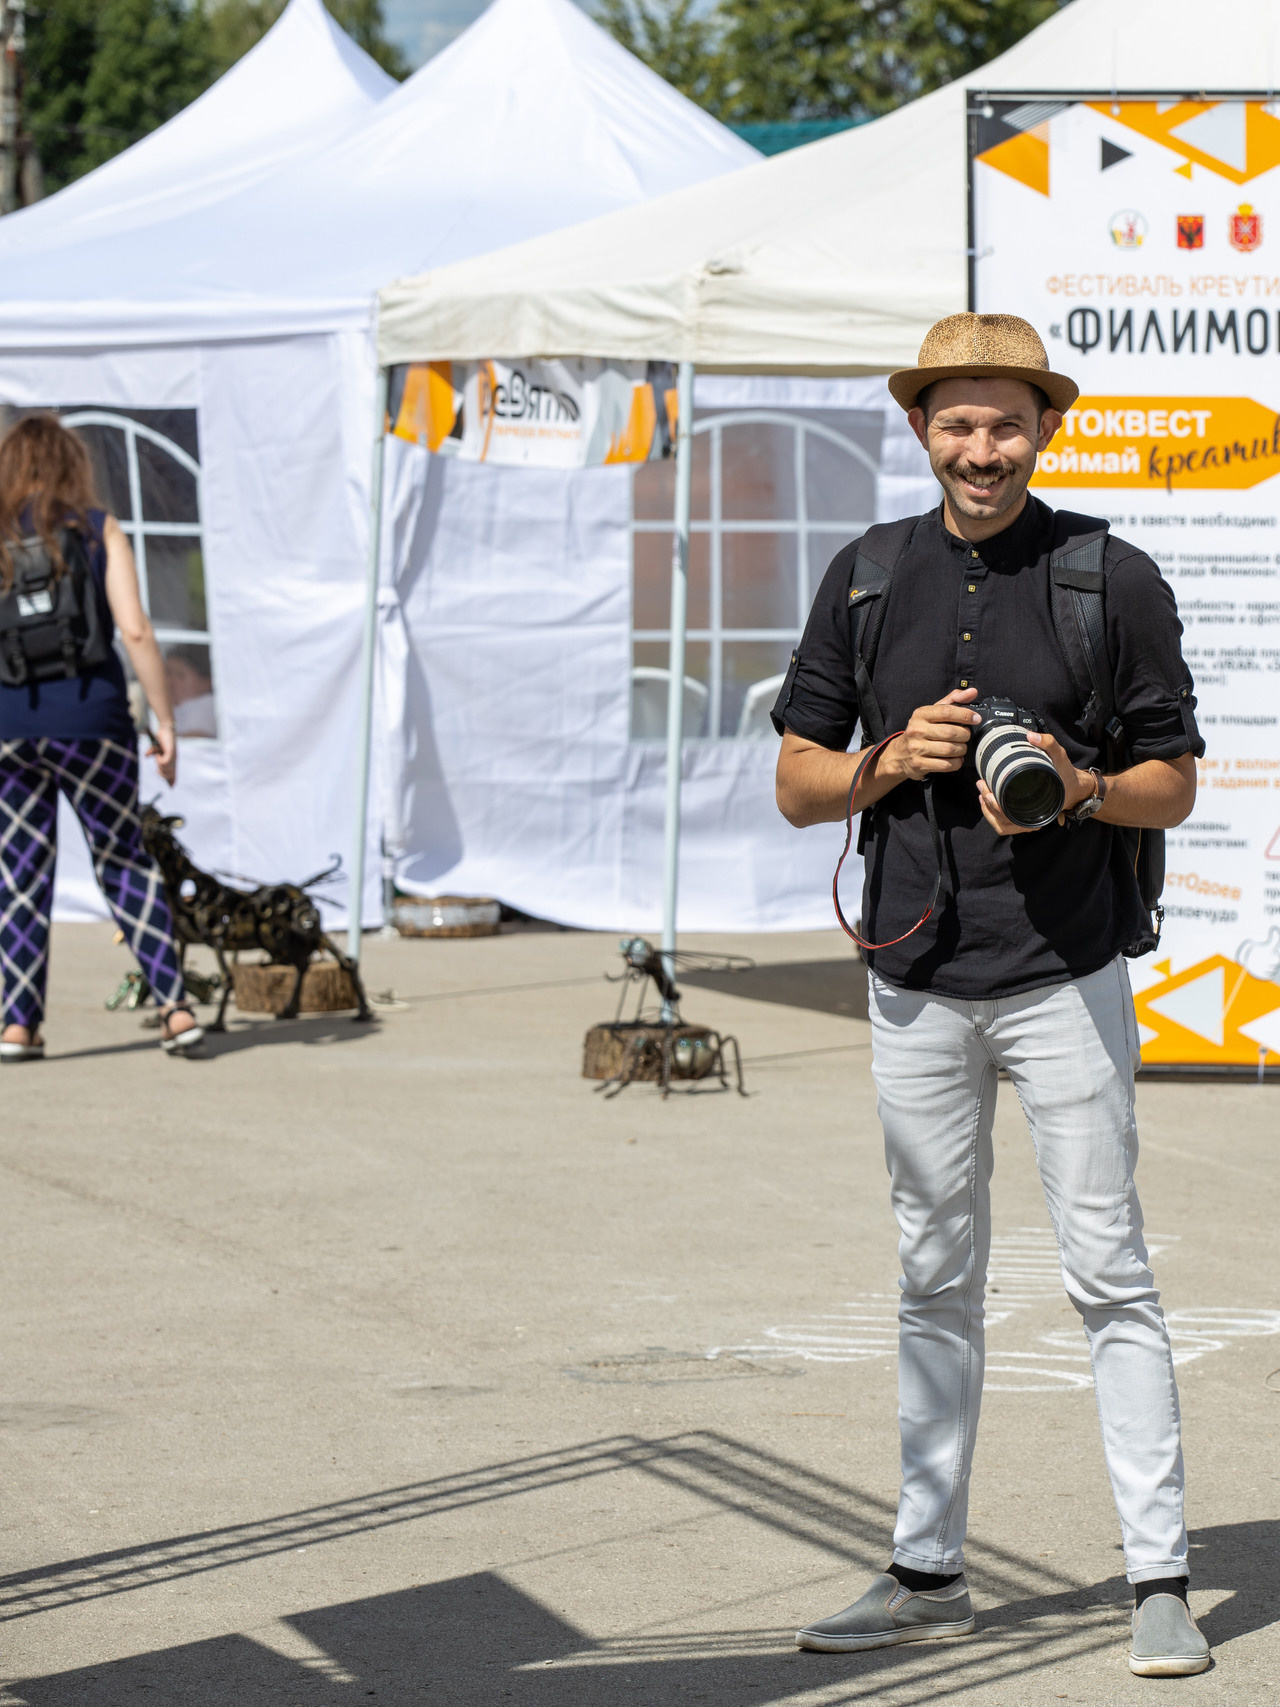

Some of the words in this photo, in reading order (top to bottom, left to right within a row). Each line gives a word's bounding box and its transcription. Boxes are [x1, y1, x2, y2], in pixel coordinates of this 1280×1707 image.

[1046, 274, 1183, 297] ФЕСТИВАЛЬ
[1064, 409, 1212, 438] ТОКВЕСТ
[1034, 446, 1141, 474] оймай
